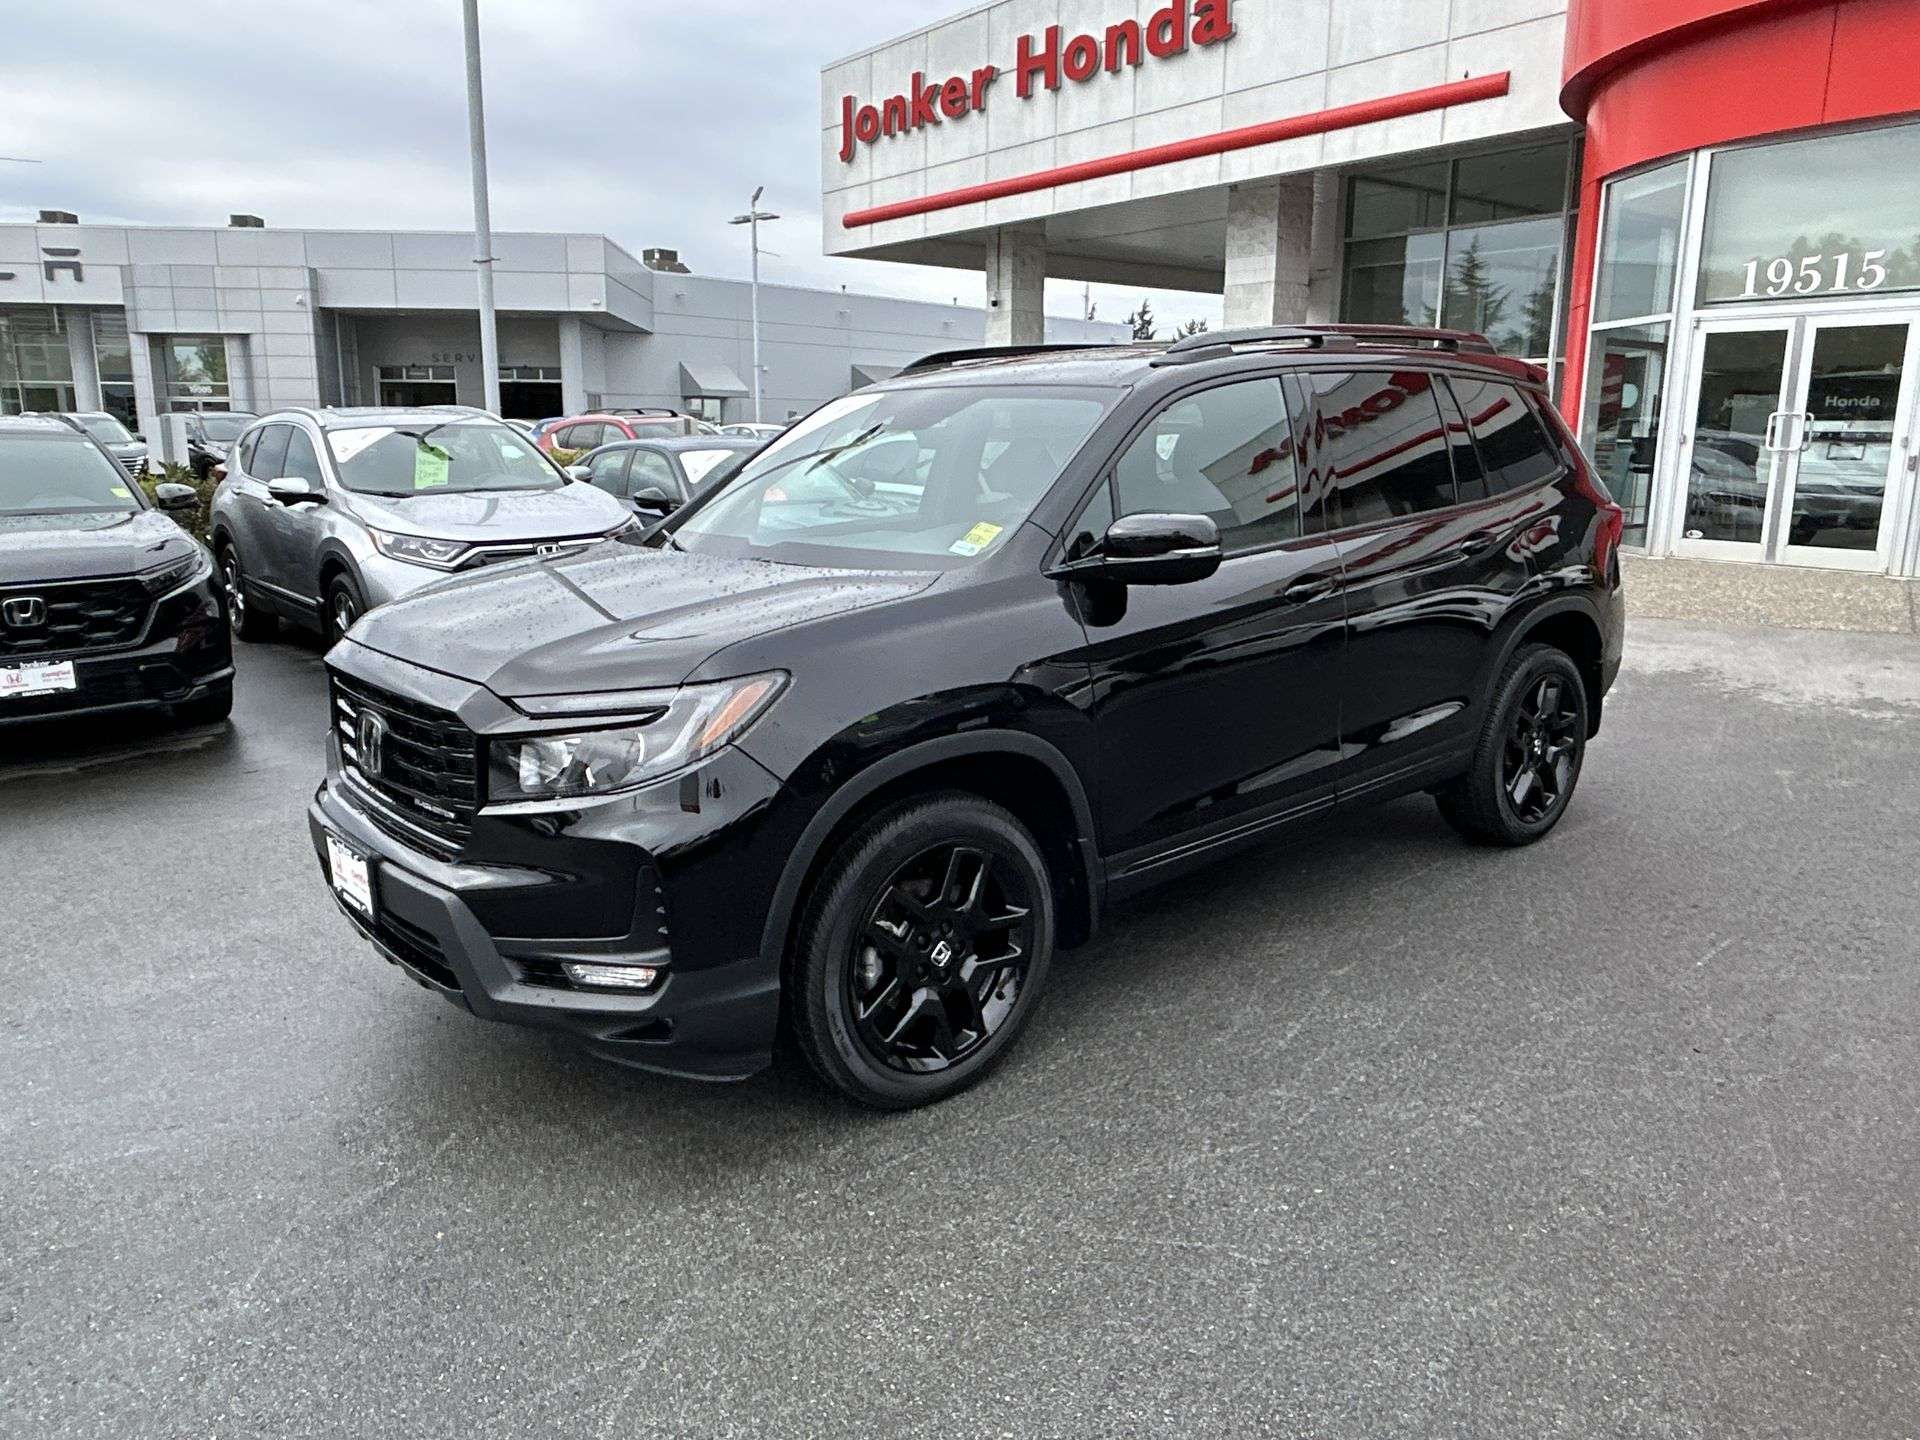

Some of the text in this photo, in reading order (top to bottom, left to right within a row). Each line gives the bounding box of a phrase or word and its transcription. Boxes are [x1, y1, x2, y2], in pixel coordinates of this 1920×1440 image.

[839, 0, 1236, 162] Jonker Honda
[1740, 250, 1887, 297] 19515
[1824, 395, 1880, 407] Honda
